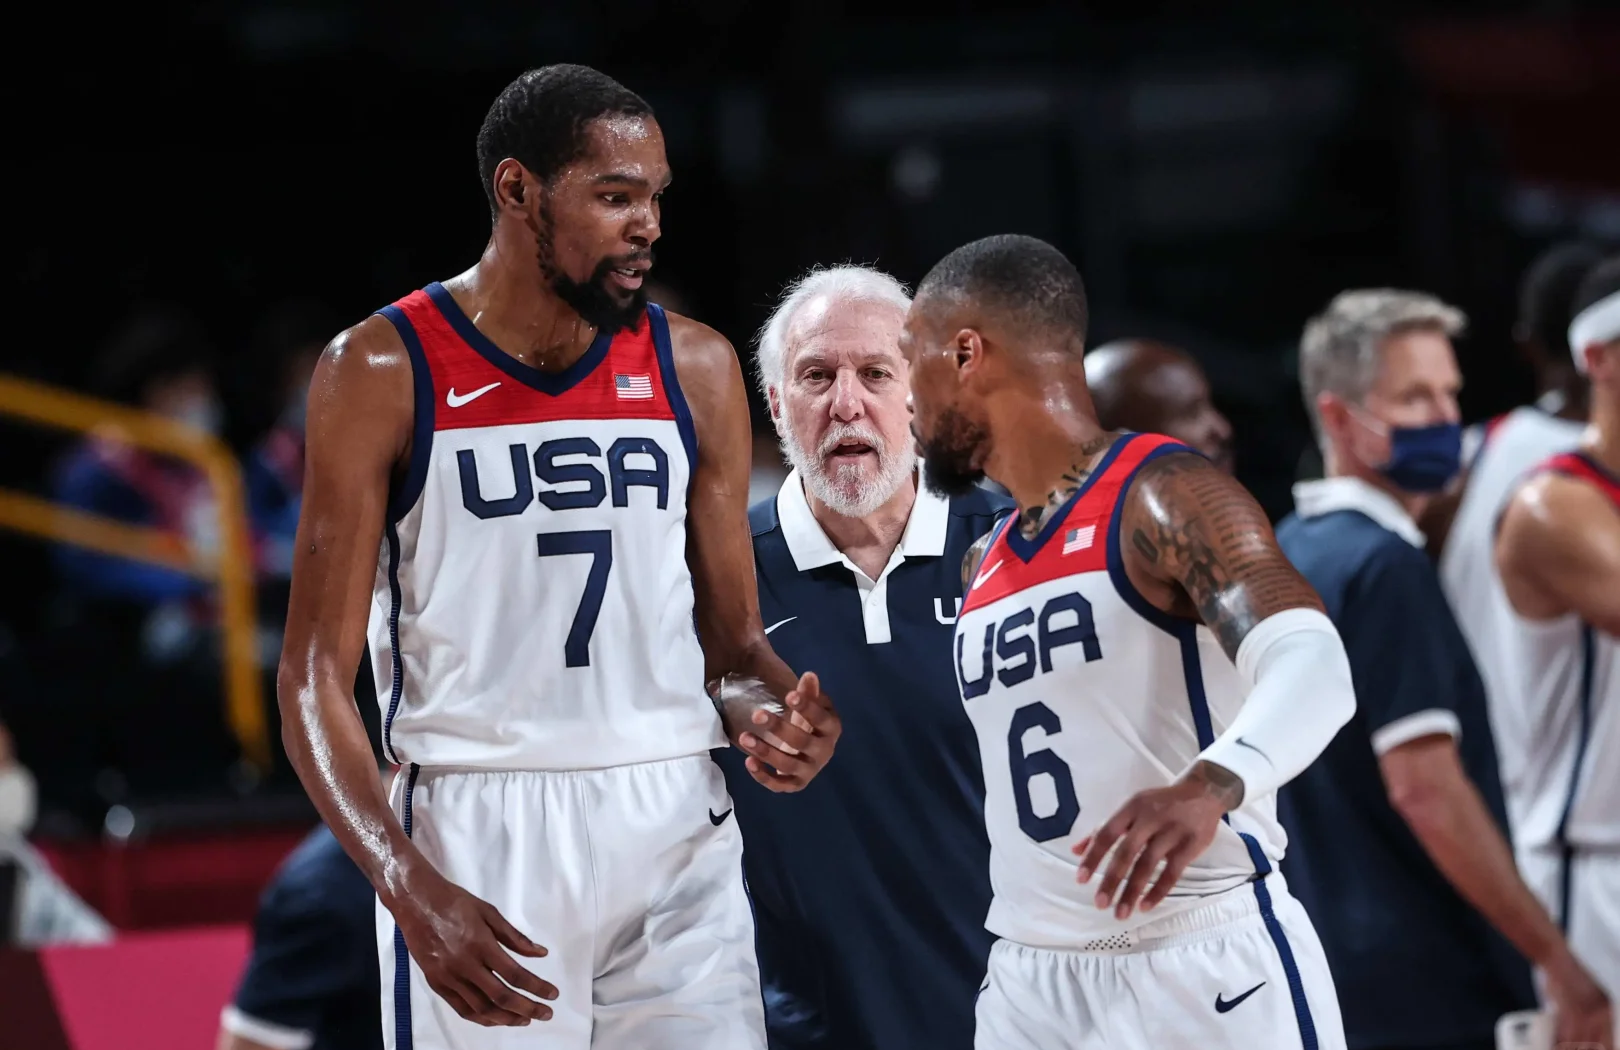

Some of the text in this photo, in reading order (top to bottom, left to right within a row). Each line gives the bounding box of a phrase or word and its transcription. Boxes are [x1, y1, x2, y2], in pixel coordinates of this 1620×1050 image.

[456, 437, 669, 520] USA
[537, 529, 613, 667] 7
[957, 591, 1103, 701] USA
[1008, 701, 1080, 843] 6
